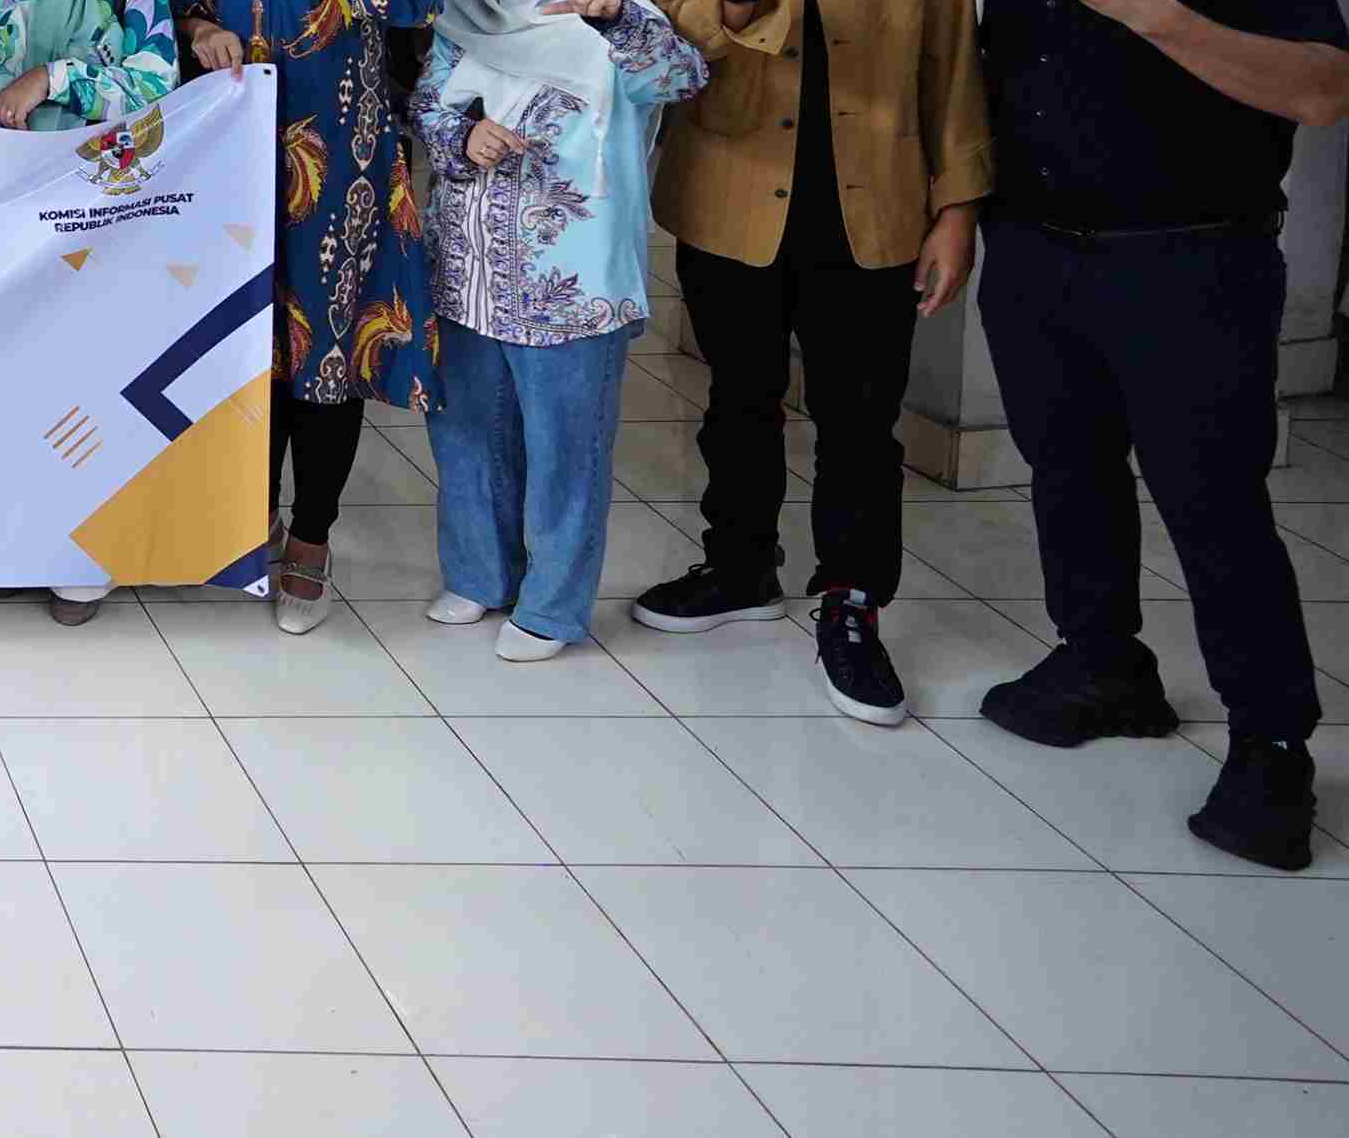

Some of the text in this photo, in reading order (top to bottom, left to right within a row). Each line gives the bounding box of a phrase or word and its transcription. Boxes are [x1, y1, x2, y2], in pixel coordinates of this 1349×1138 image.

[39, 193, 194, 222] KOMISI INFORMASI PUSAT
[54, 205, 180, 233] REPUBLIK INDONESIA
